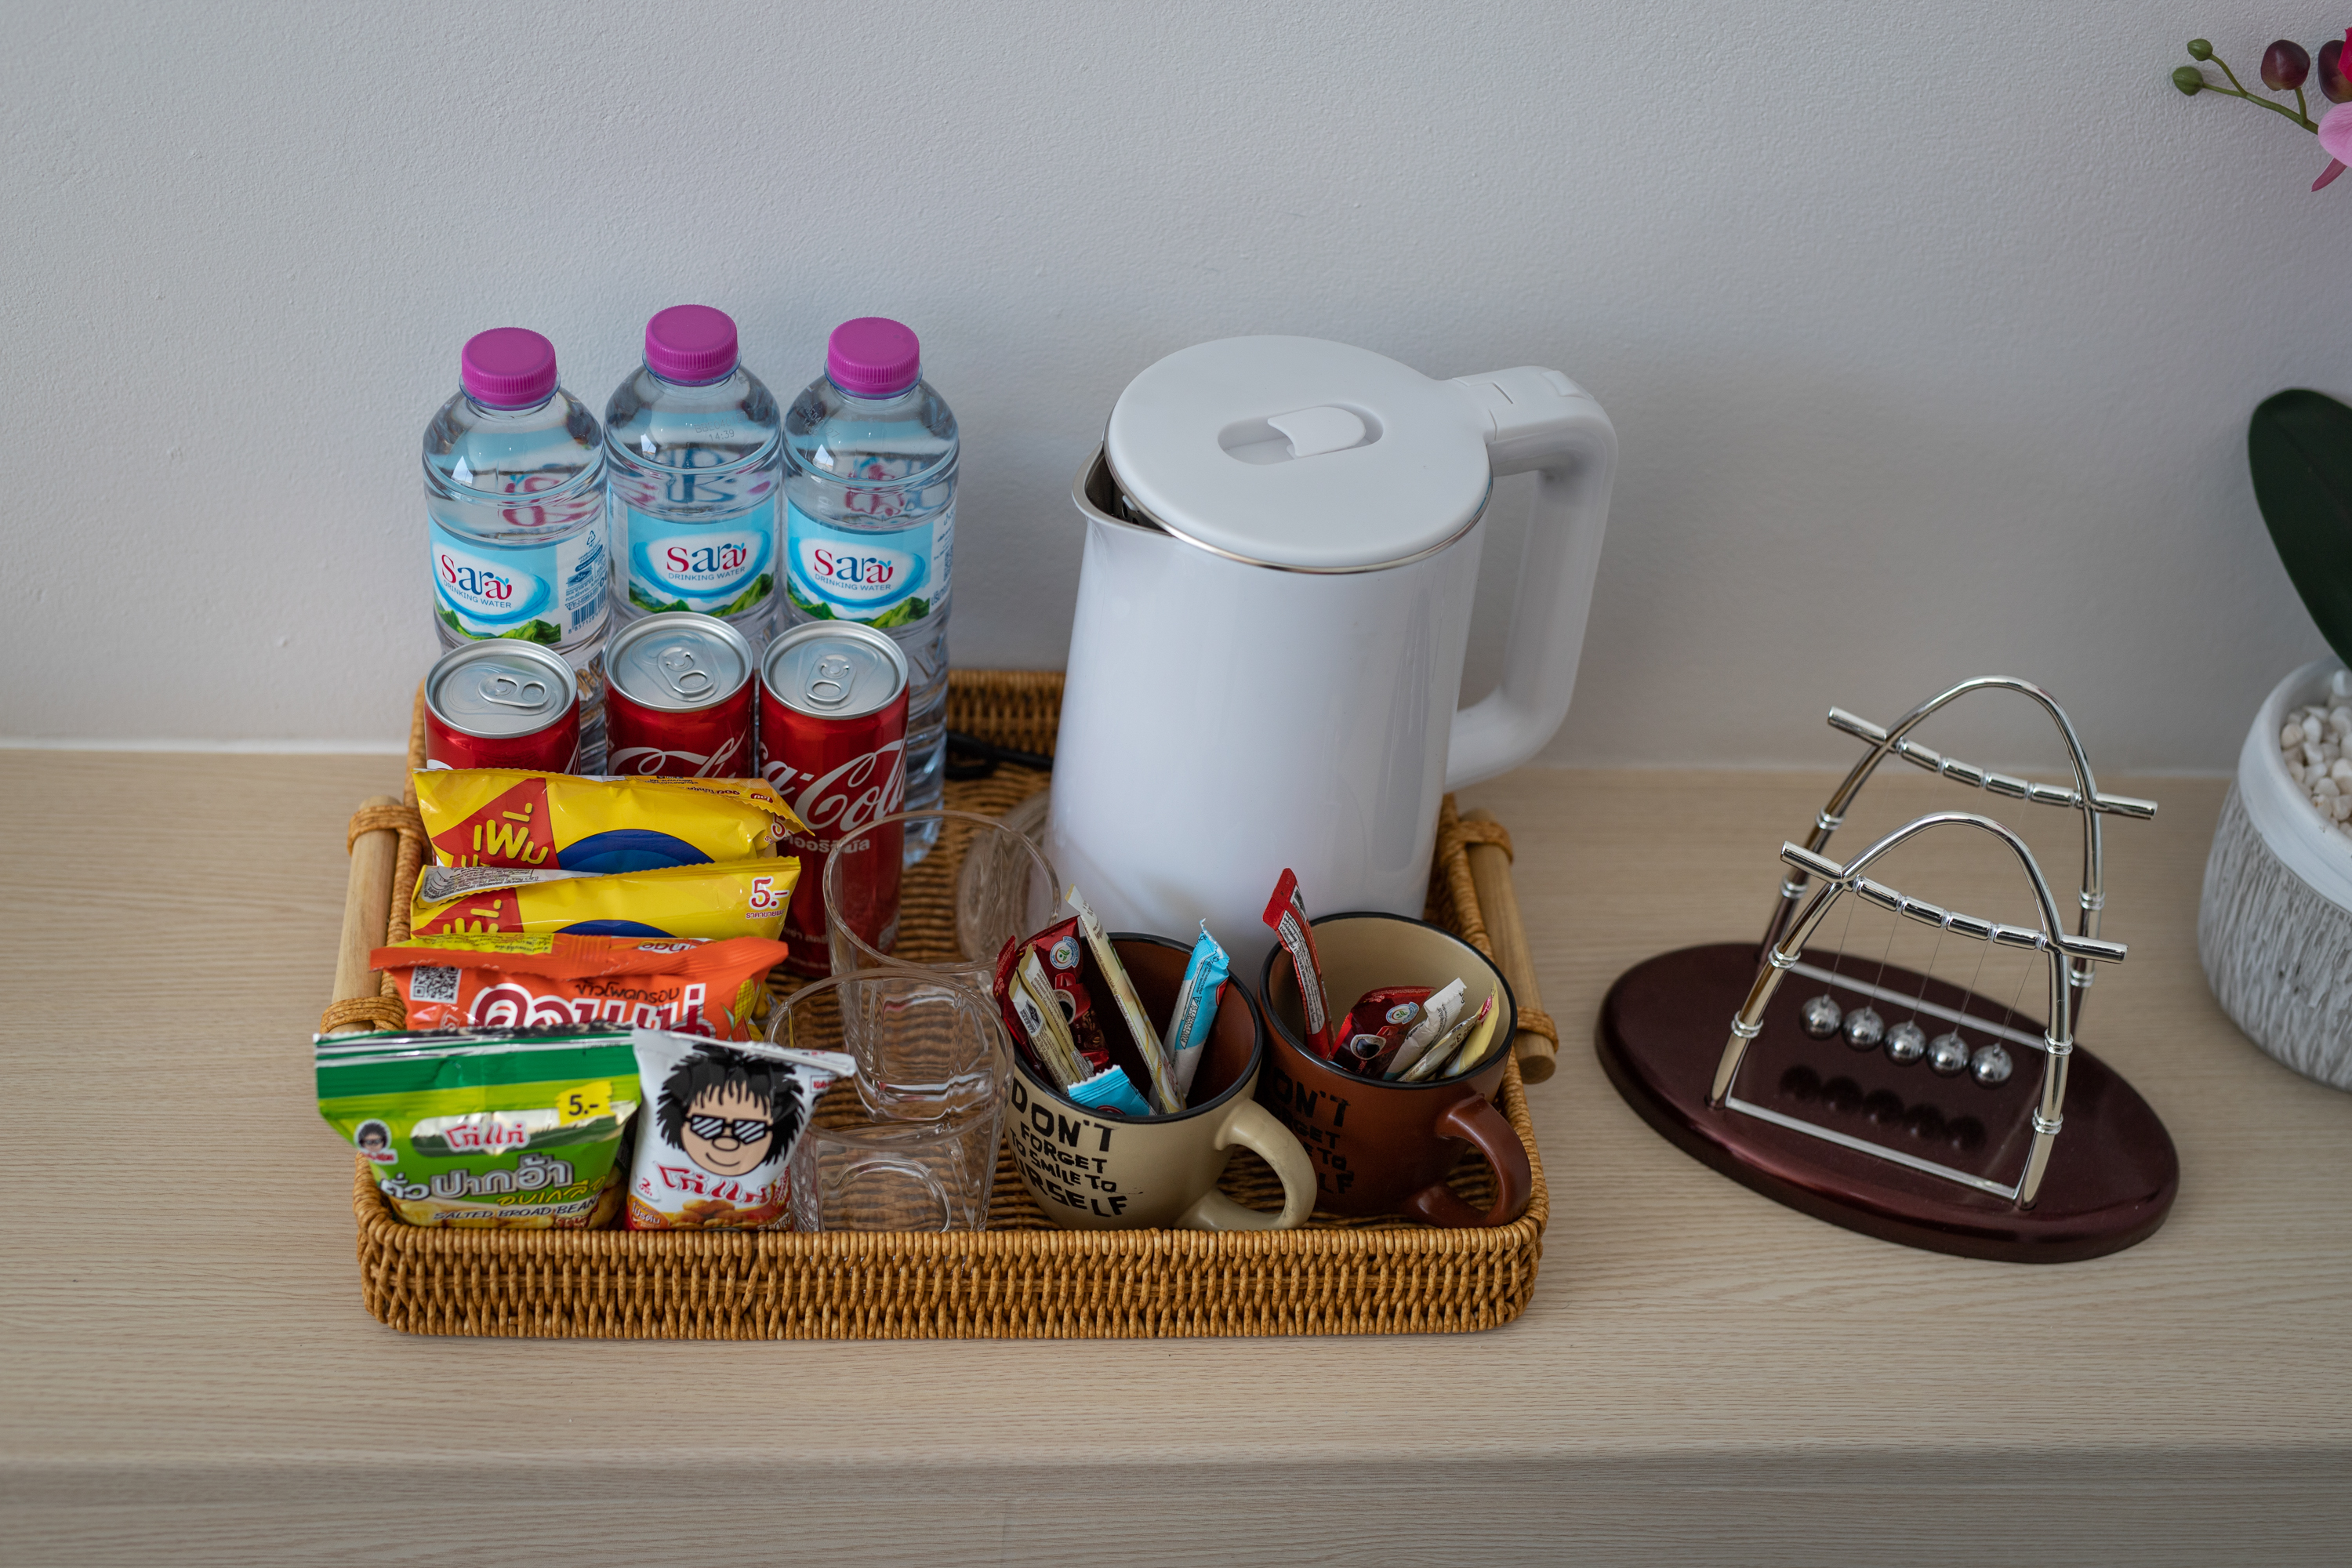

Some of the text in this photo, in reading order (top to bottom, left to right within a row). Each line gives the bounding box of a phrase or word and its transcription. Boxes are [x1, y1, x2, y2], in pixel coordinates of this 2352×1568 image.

[443, 579, 512, 608] DRINKING WATER
[668, 566, 746, 581] DRINKING WATER
[815, 573, 858, 590] DRINKING
[473, 802, 549, 865] เพิ่ม
[575, 980, 680, 1005] ข้าวโพดกรอบ
[568, 1094, 600, 1116] 5.-
[1011, 1076, 1119, 1152] DON'T
[1272, 1066, 1351, 1127] ON'T
[1010, 1127, 1117, 1192] TO SMILE TO
[1020, 1120, 1108, 1174] FORGET
[1012, 1151, 1127, 1218] URSELF
[433, 1209, 493, 1220] SALTED
[497, 1207, 552, 1217] BROAD
